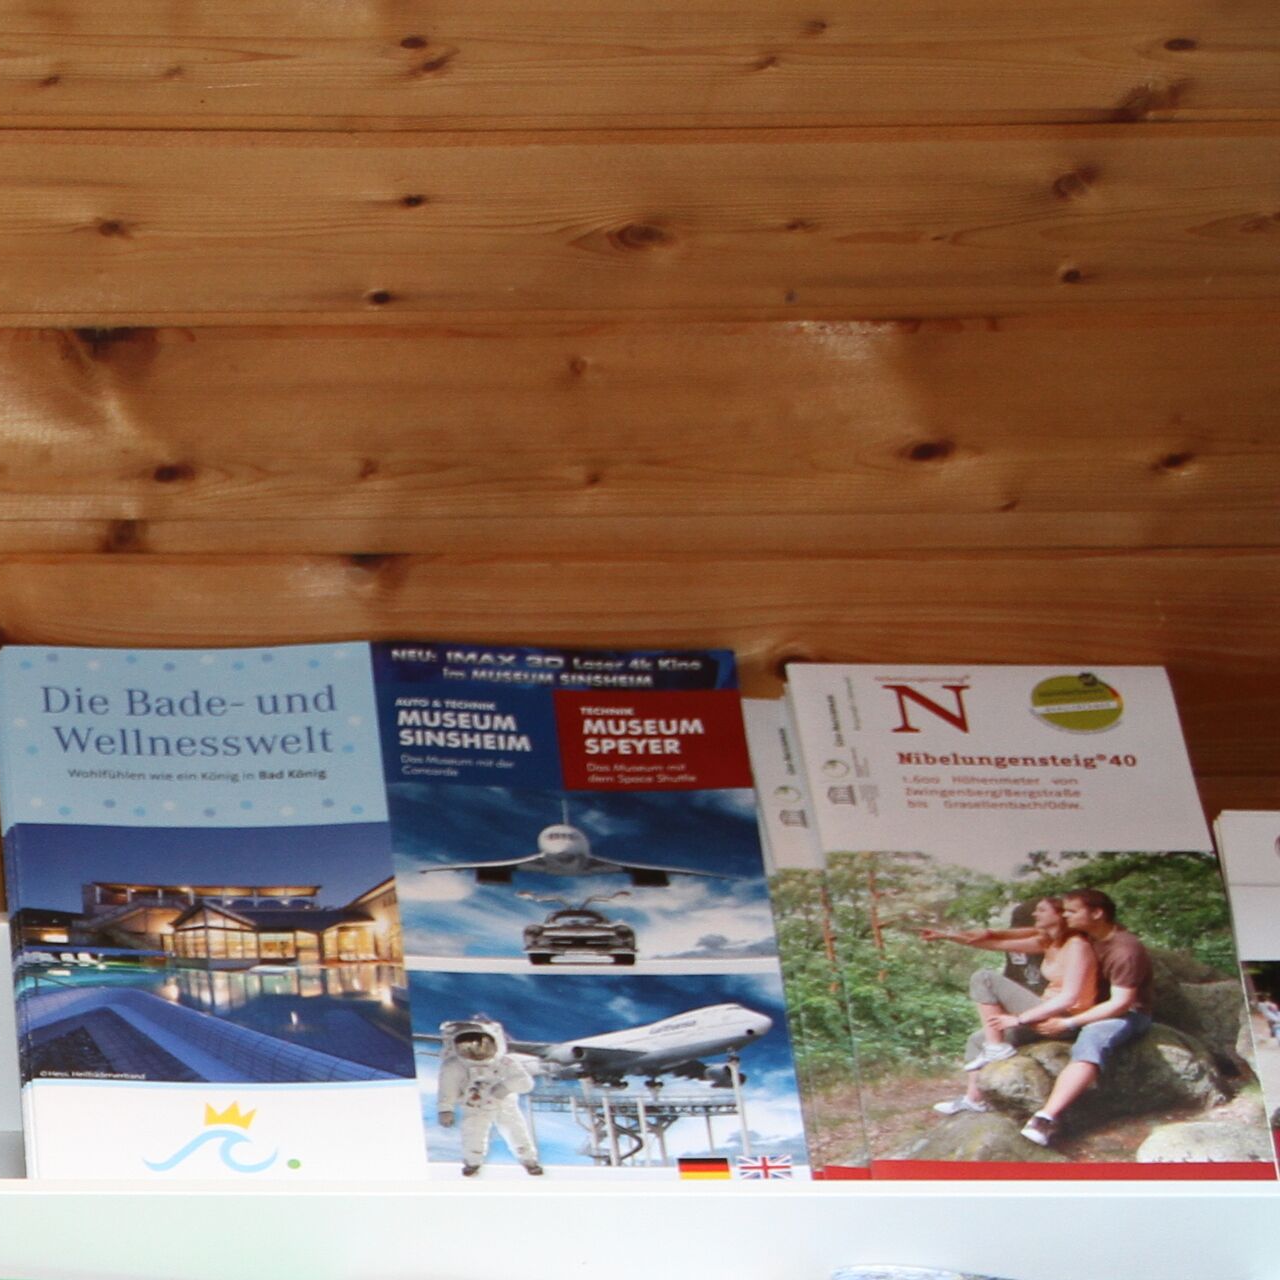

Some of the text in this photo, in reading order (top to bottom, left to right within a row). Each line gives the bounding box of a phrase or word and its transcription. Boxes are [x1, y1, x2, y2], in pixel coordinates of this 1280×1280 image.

[391, 648, 702, 671] NEU: IMAX 3D Laser Kino
[472, 669, 653, 687] MUSEUM SINSHEIM
[41, 685, 337, 717] Die Bade- und
[395, 698, 497, 711] AUTO TECHNIK
[882, 684, 970, 734] N
[579, 706, 635, 716] TECHNIK
[397, 710, 517, 731] MUSEUM
[582, 718, 705, 735] MUSEUM
[51, 726, 335, 757] Wellnesswelt
[399, 730, 532, 752] SINSHEIM
[584, 738, 682, 755] SPEYER
[426, 755, 473, 766] Museum
[68, 767, 328, 784] Wohlfühlen wie ein König in Bad König
[1051, 777, 1079, 786] von
